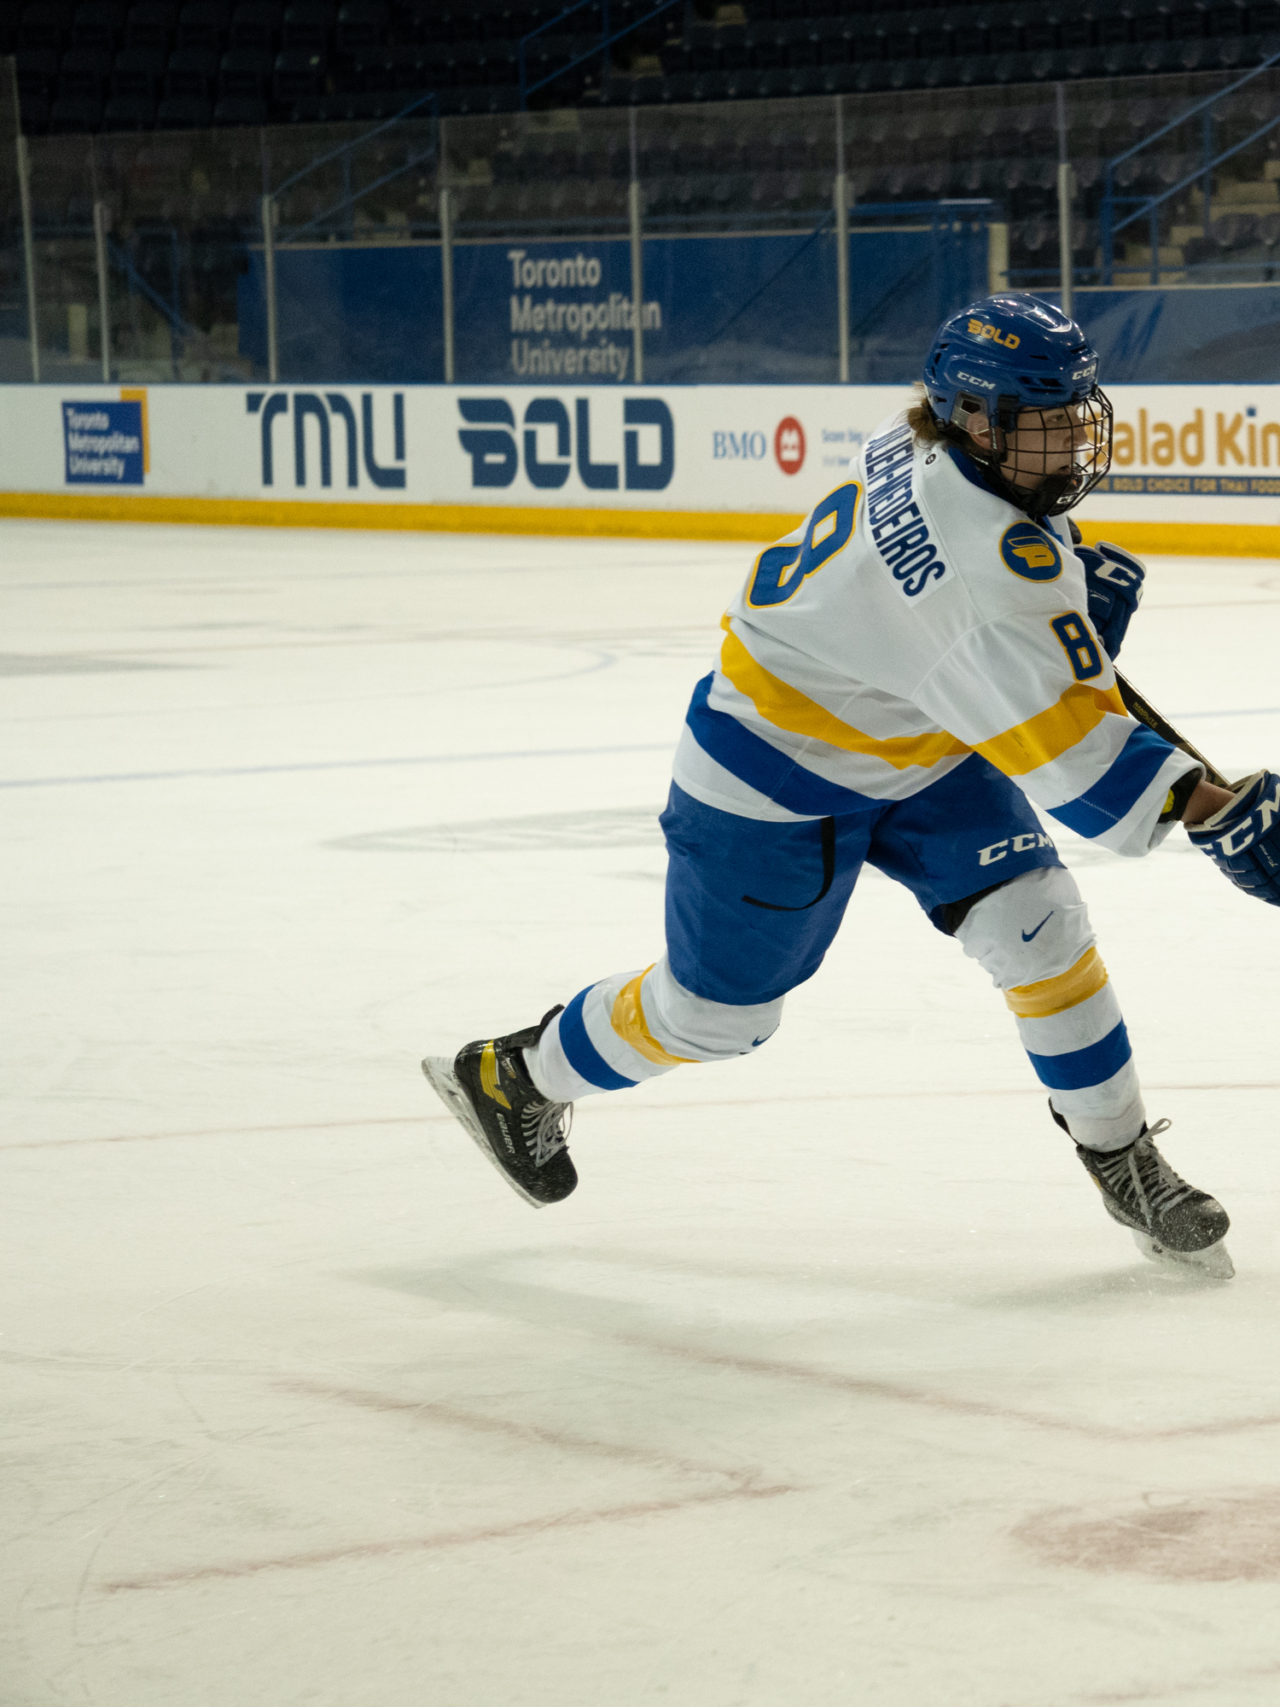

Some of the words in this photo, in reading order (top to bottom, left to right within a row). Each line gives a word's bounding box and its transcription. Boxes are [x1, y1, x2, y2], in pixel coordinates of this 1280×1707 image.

[507, 250, 601, 288] Toronto
[510, 292, 661, 341] Metropolitn
[967, 319, 1021, 350] BOLD
[511, 338, 630, 382] University
[956, 371, 996, 390] CCM
[66, 408, 109, 430] Toronto
[68, 431, 140, 455] Metropolitan
[246, 392, 406, 489] TMU
[457, 397, 675, 491] BOLD
[712, 430, 767, 461] BMO
[69, 454, 125, 480] University
[1112, 477, 1144, 492] BOLD
[1147, 478, 1191, 493] CHOICE
[1194, 478, 1217, 493] FOR
[746, 480, 862, 610] 8
[1049, 610, 1104, 682] 8
[977, 832, 1054, 867] CCM
